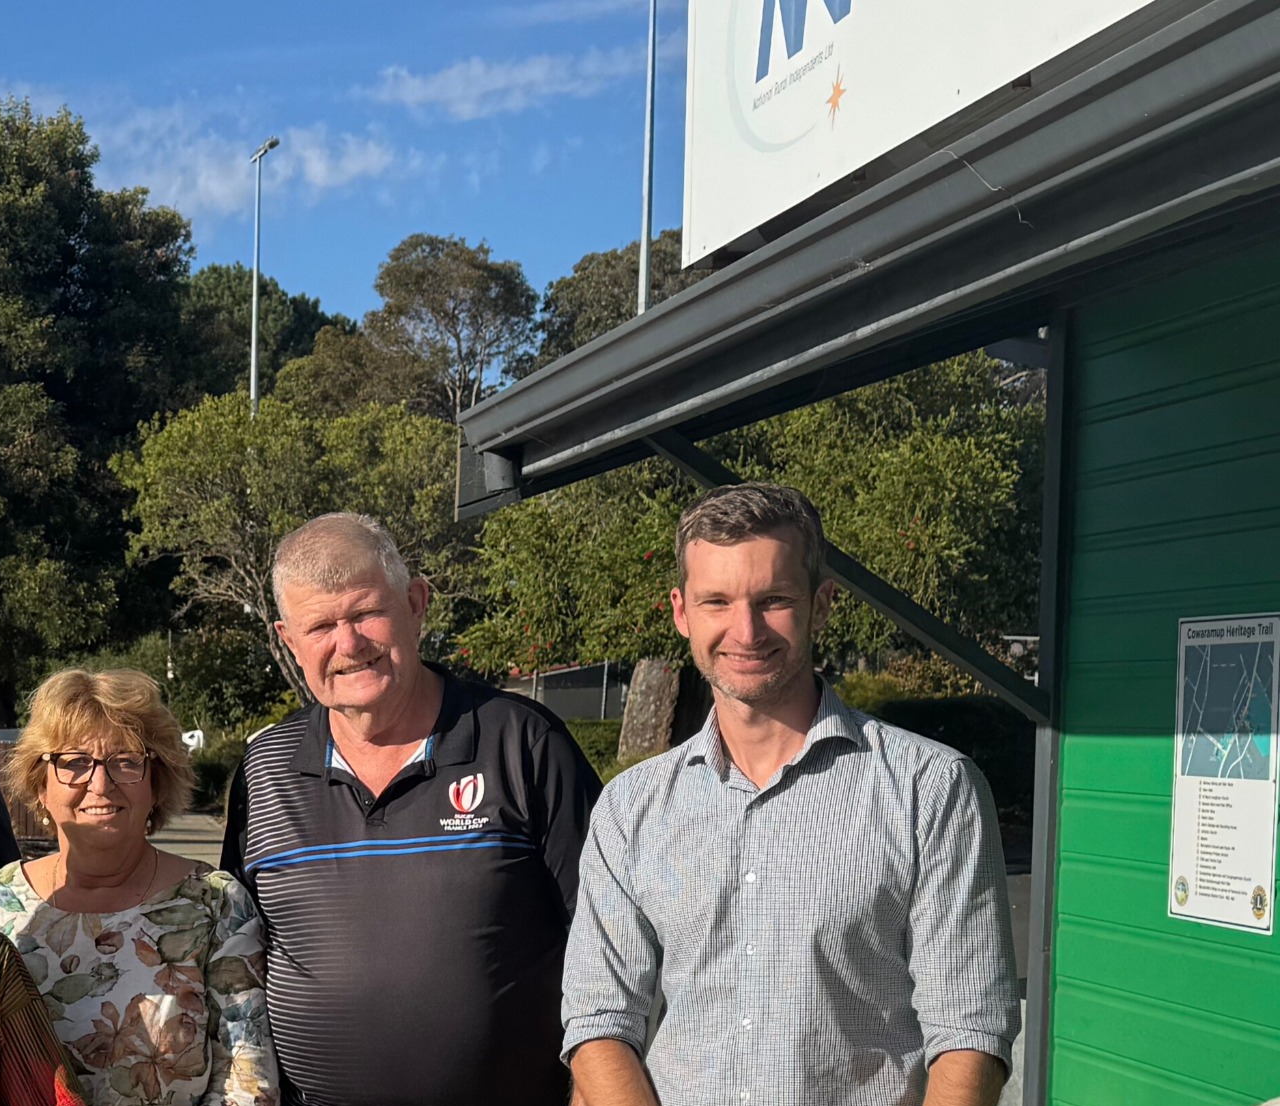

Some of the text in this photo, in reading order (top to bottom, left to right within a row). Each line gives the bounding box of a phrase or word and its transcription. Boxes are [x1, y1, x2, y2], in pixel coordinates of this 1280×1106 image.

[1187, 622, 1274, 640] Cowaramup Heritage Trail
[439, 816, 490, 826] WORLD CUP
